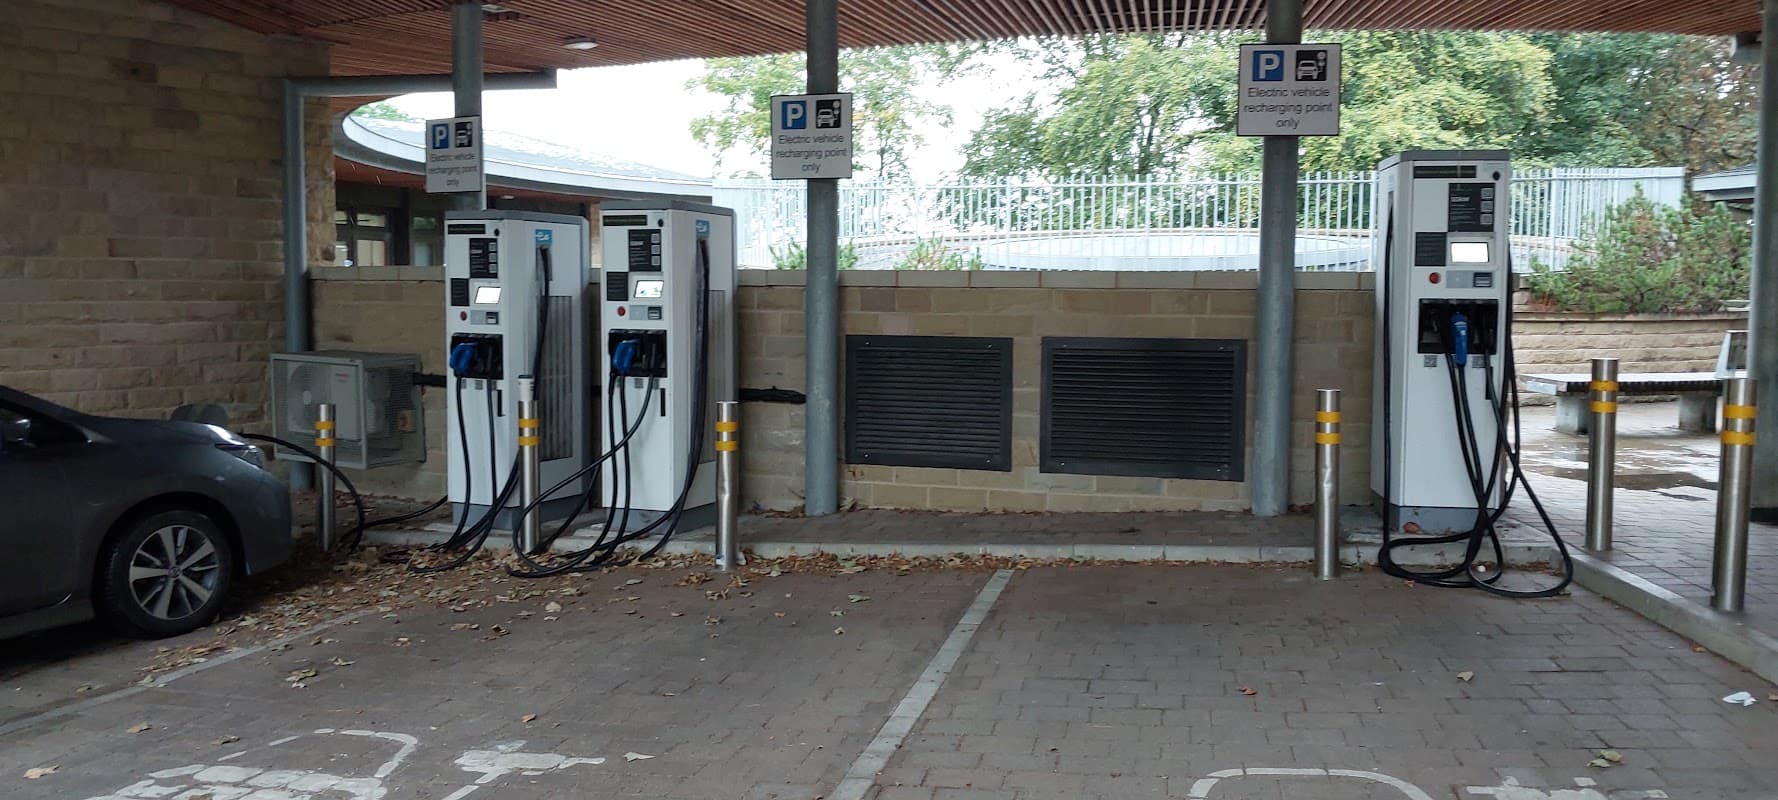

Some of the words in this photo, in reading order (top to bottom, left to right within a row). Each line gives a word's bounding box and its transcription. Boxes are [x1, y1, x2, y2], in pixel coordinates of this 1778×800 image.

[1258, 53, 1281, 80] P
[1247, 87, 1288, 98] Electric
[1291, 87, 1330, 97] vehicle
[1244, 103, 1303, 114] recharging
[1306, 103, 1333, 114] point
[786, 103, 804, 128] P
[1275, 118, 1301, 130] only
[434, 126, 447, 148] P
[778, 135, 811, 145] Electric
[813, 134, 844, 144] vehicle
[776, 148, 822, 160] recharging
[824, 148, 847, 160] point
[801, 162, 821, 174] only
